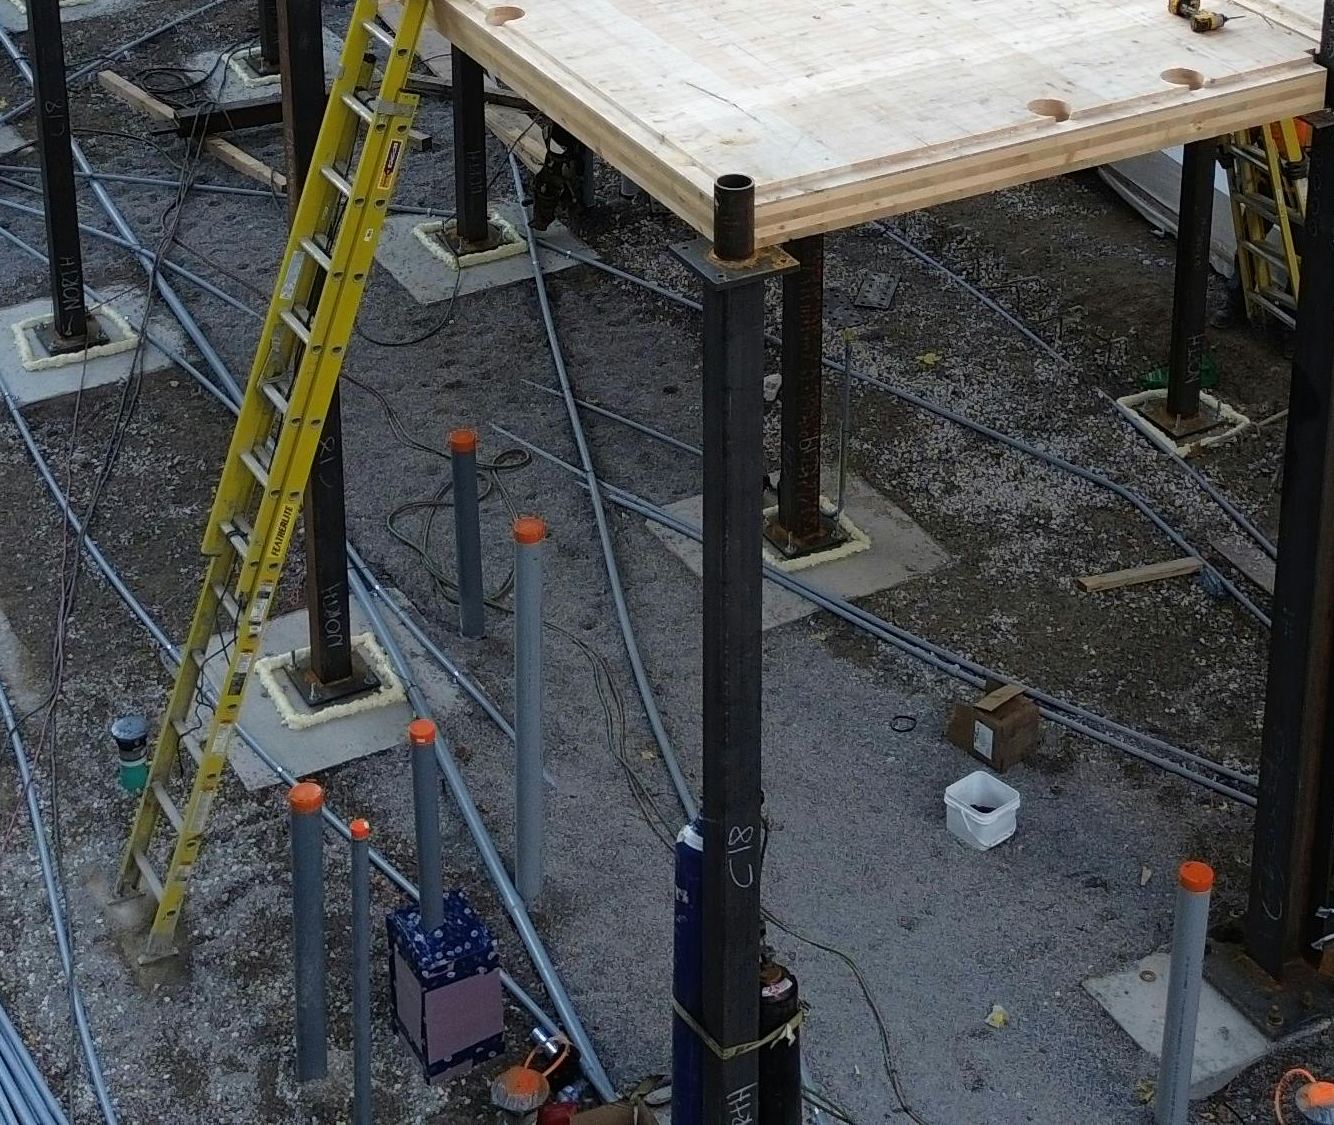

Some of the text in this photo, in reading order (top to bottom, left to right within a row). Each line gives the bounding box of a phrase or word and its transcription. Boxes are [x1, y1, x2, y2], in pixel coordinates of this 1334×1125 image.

[60, 257, 82, 311] NORTH
[270, 505, 294, 557] FEATHERLITE
[321, 580, 344, 648] NORTH
[727, 825, 754, 888] C18
